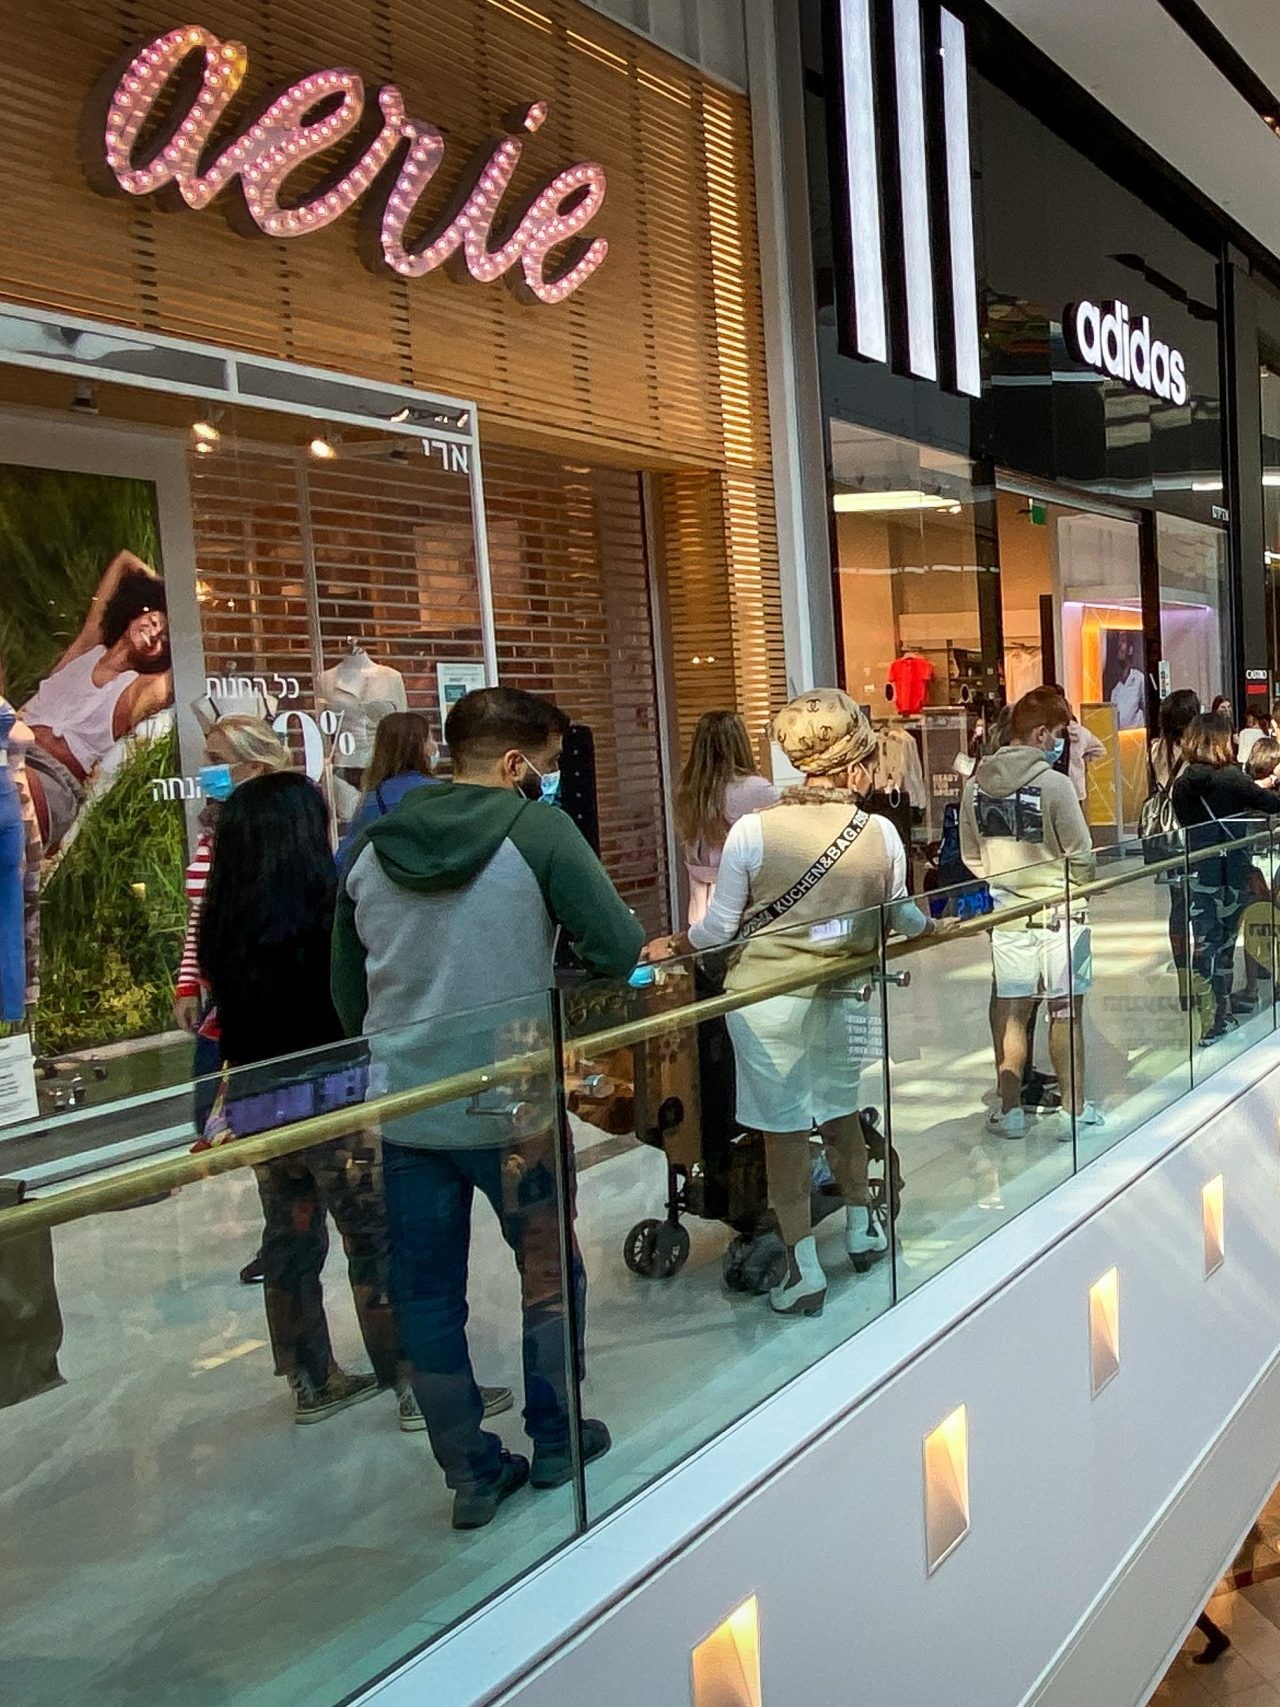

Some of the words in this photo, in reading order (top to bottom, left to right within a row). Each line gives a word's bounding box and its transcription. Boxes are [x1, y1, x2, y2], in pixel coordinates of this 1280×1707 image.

[105, 24, 609, 303] aerie
[1076, 299, 1187, 406] adidas
[421, 438, 470, 474] ארי
[205, 675, 269, 701] החנות
[273, 672, 300, 699] כל
[271, 709, 357, 784] 0%
